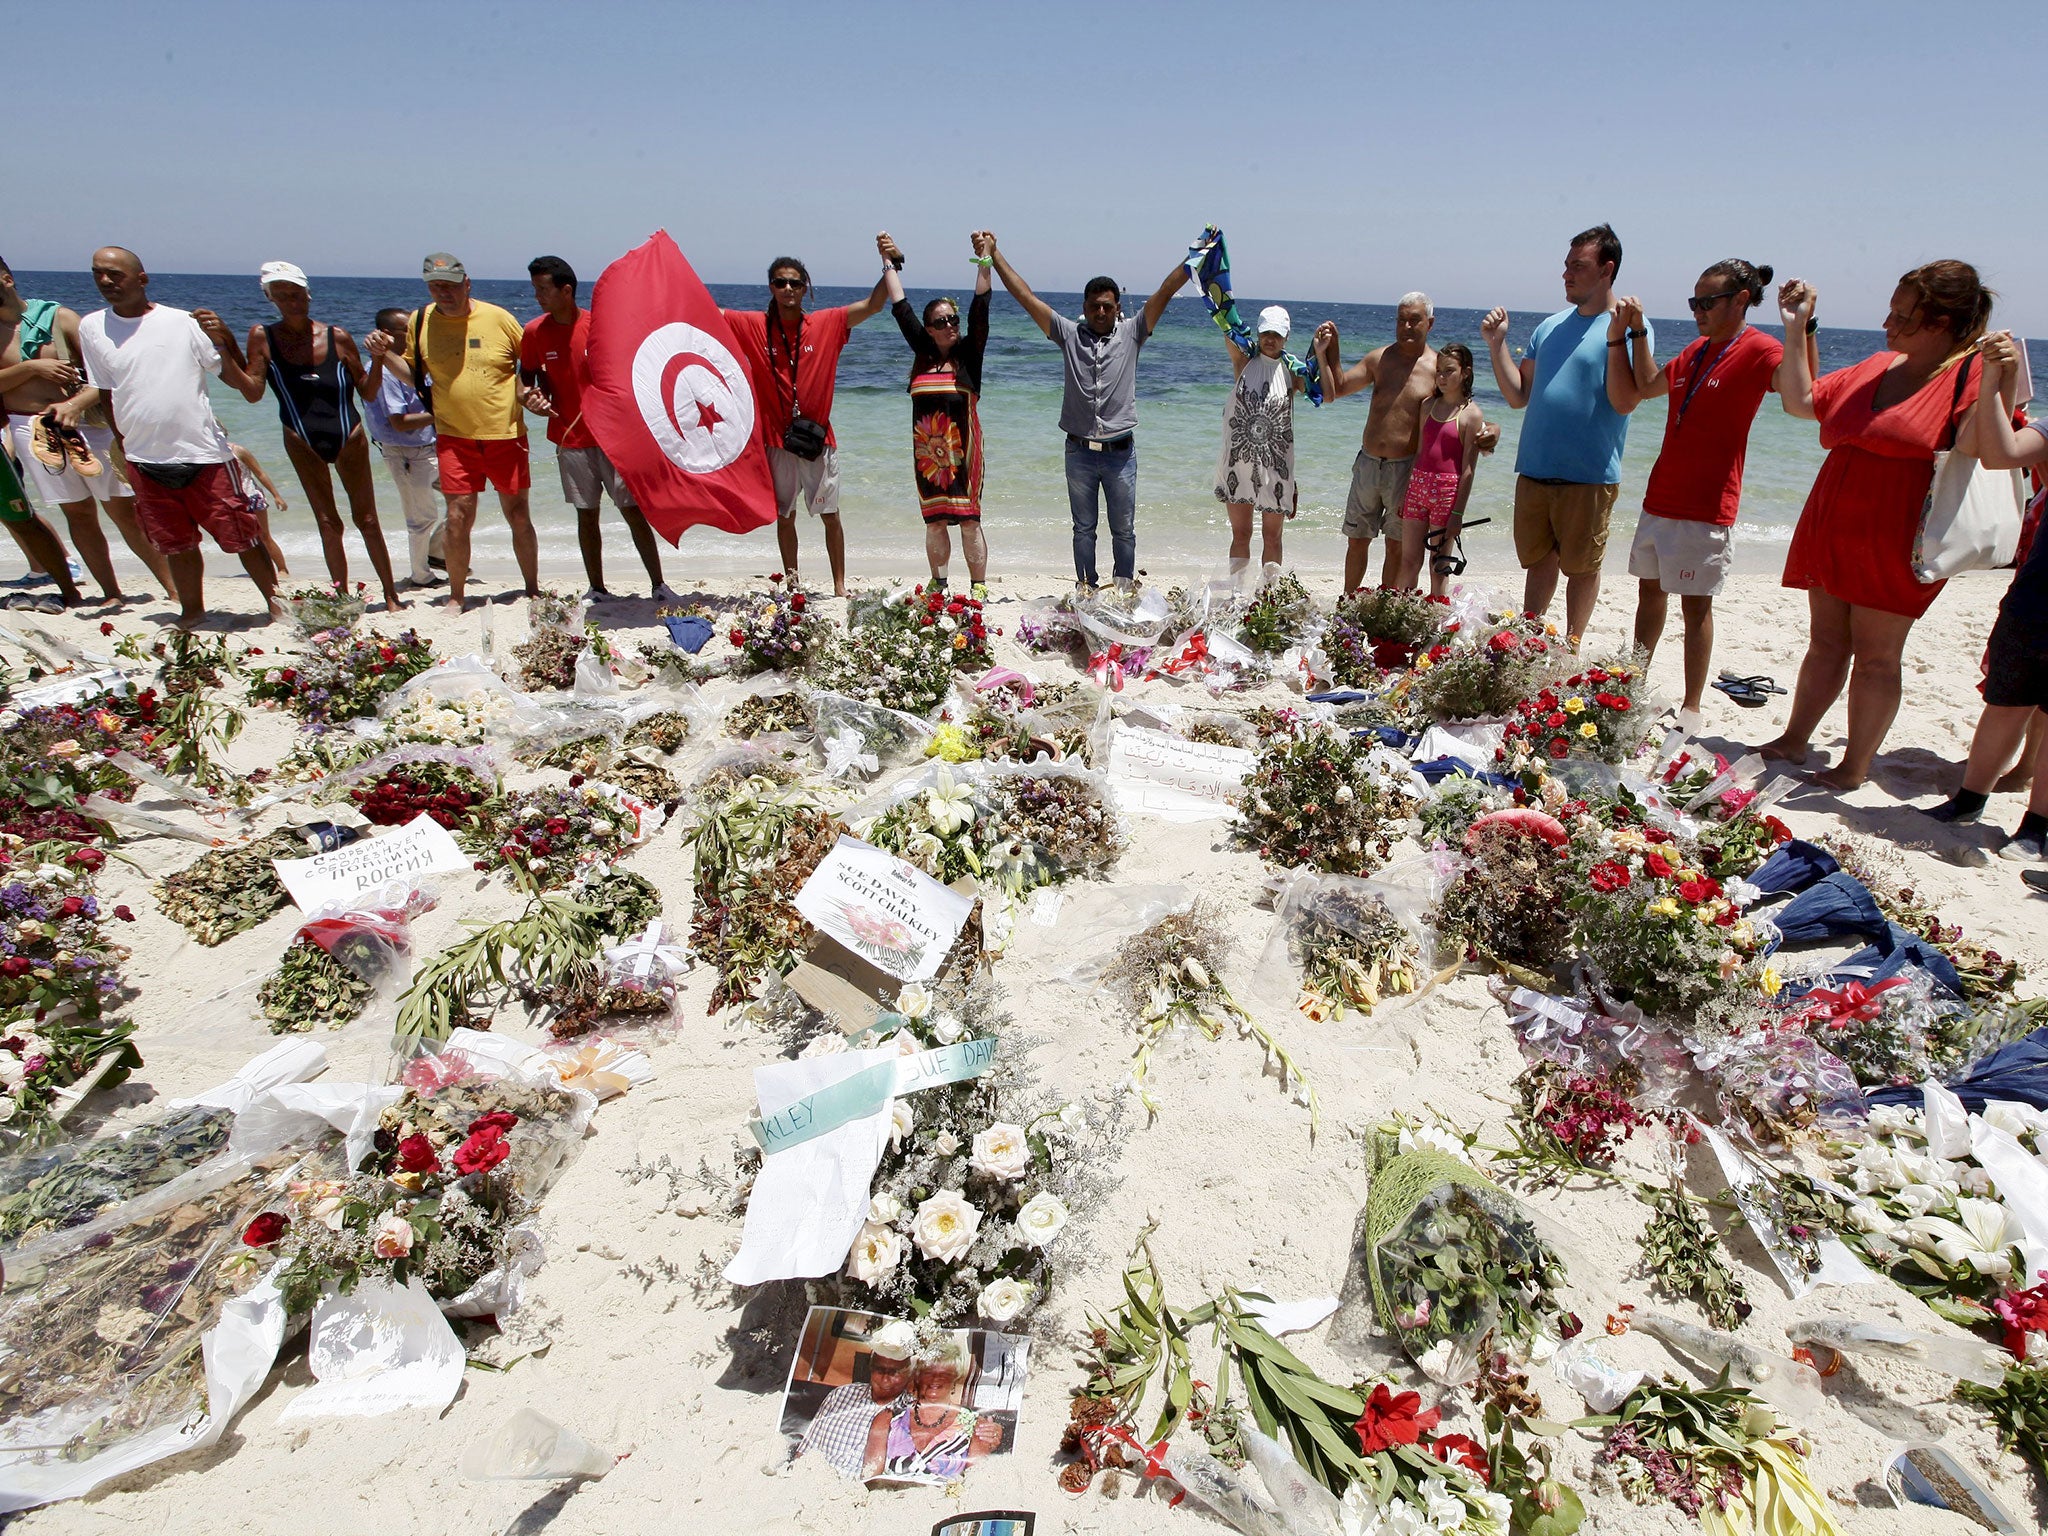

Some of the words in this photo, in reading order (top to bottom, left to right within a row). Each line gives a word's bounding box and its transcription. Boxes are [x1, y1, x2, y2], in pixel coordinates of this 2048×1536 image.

[836, 861, 869, 882] SUE
[870, 878, 922, 915] DAVEY
[836, 871, 880, 901] SCOTT
[878, 897, 943, 943] CHALKLEY
[760, 1096, 815, 1148] KLEY
